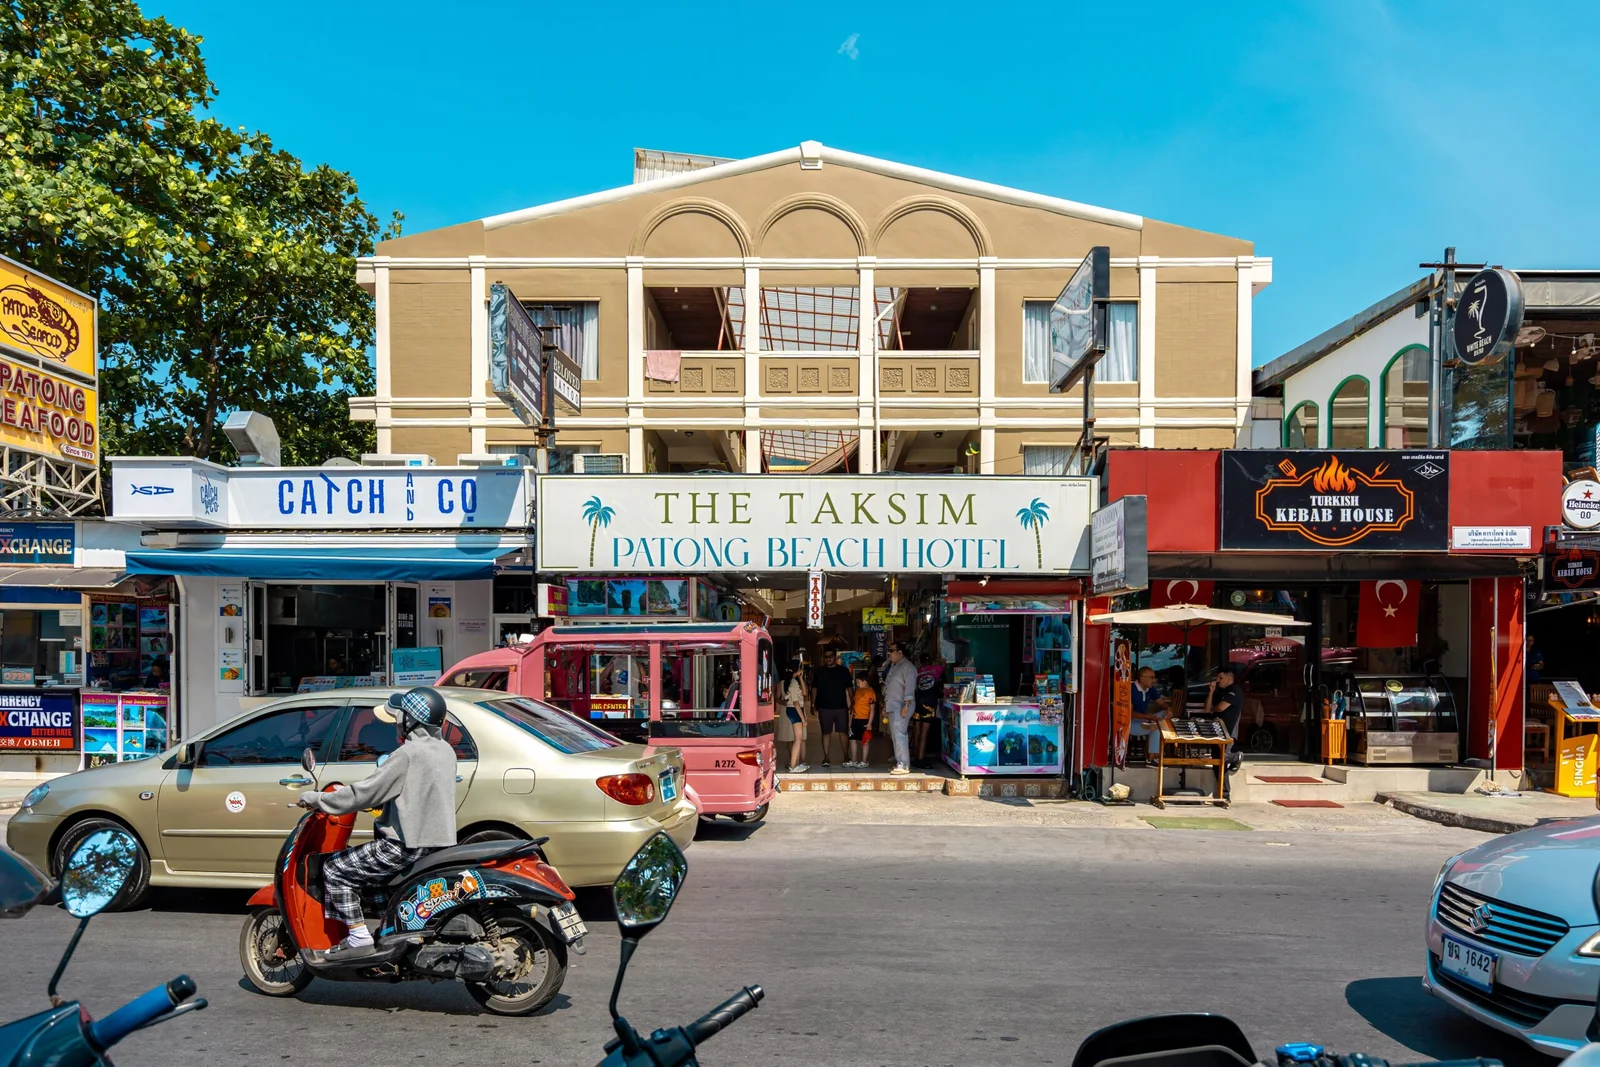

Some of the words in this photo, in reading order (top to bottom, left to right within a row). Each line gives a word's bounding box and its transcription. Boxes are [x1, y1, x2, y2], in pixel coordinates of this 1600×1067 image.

[20, 320, 62, 349] SEAFOOD
[0, 362, 85, 414] PATONG
[554, 357, 580, 391] BELOVED
[554, 375, 579, 405] TATTOO
[0, 398, 95, 447] EAFOOD
[66, 446, 80, 456] Since
[81, 450, 94, 459] 1979
[278, 472, 384, 514] CATCH
[1310, 496, 1359, 506] TURKISH
[654, 492, 752, 524] THE
[778, 492, 977, 525] TAKSIM
[1276, 508, 1333, 522] KEBAB
[1340, 508, 1394, 522] HOUSE
[613, 537, 750, 568] PATONG
[767, 537, 884, 568] BEACH
[902, 538, 1020, 568] HOTEL
[1558, 568, 1574, 577] KEBAB
[1576, 567, 1592, 576] HOUSE
[0, 711, 72, 727] XCHANGE
[32, 728, 54, 736] BETTER
[56, 728, 72, 736] RATE
[1574, 745, 1585, 786] SINGHA
[1466, 950, 1490, 974] 1642
